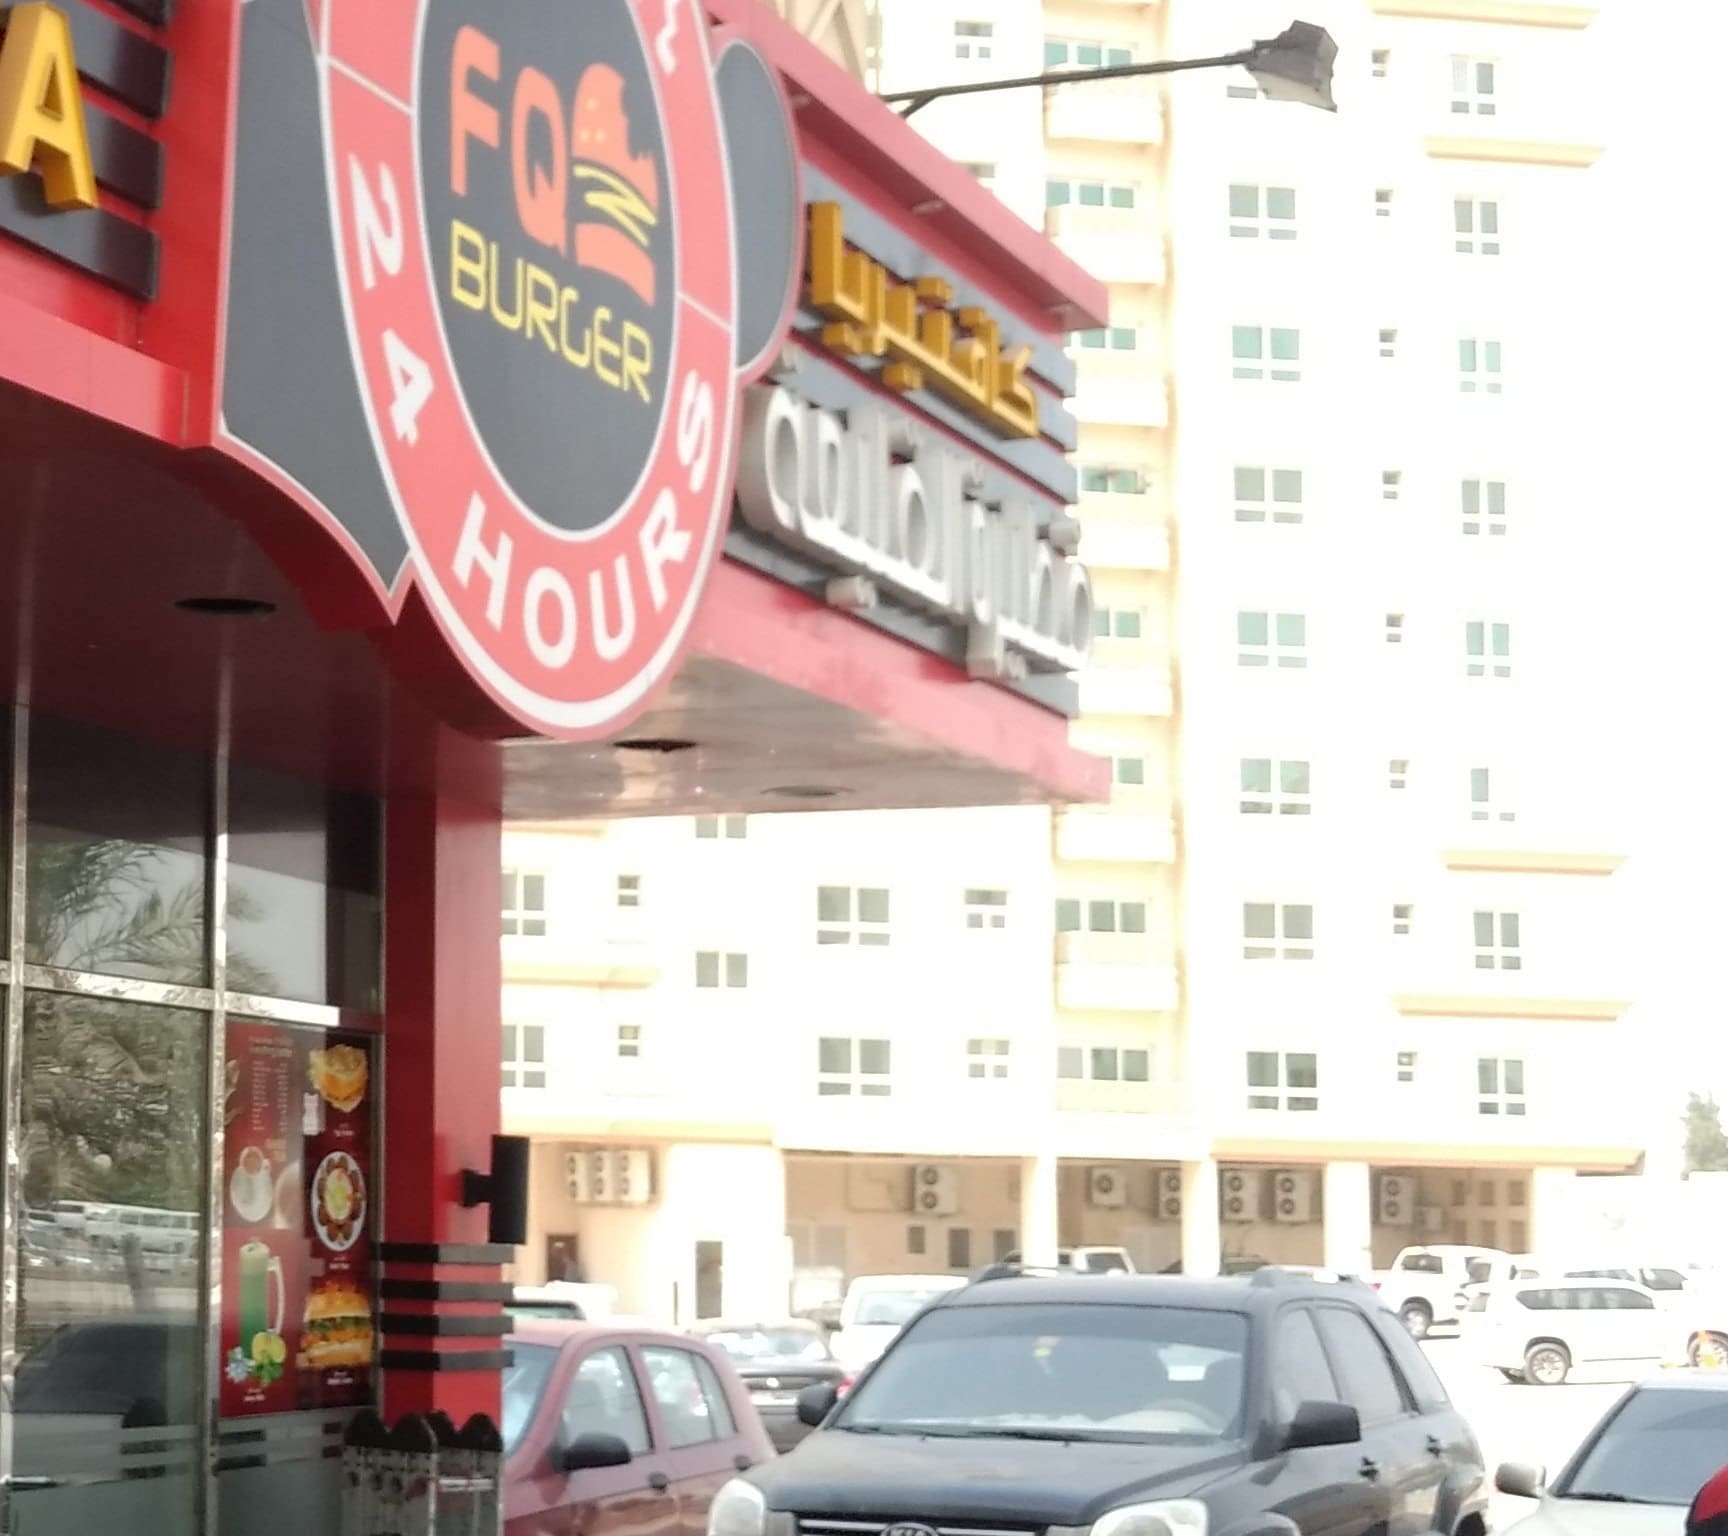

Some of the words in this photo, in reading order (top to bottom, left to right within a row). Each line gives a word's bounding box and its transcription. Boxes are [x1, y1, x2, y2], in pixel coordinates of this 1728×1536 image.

[449, 23, 569, 261] FQ
[345, 151, 435, 445] 24
[451, 367, 715, 670] HOURS
[450, 219, 654, 406] BURGER
